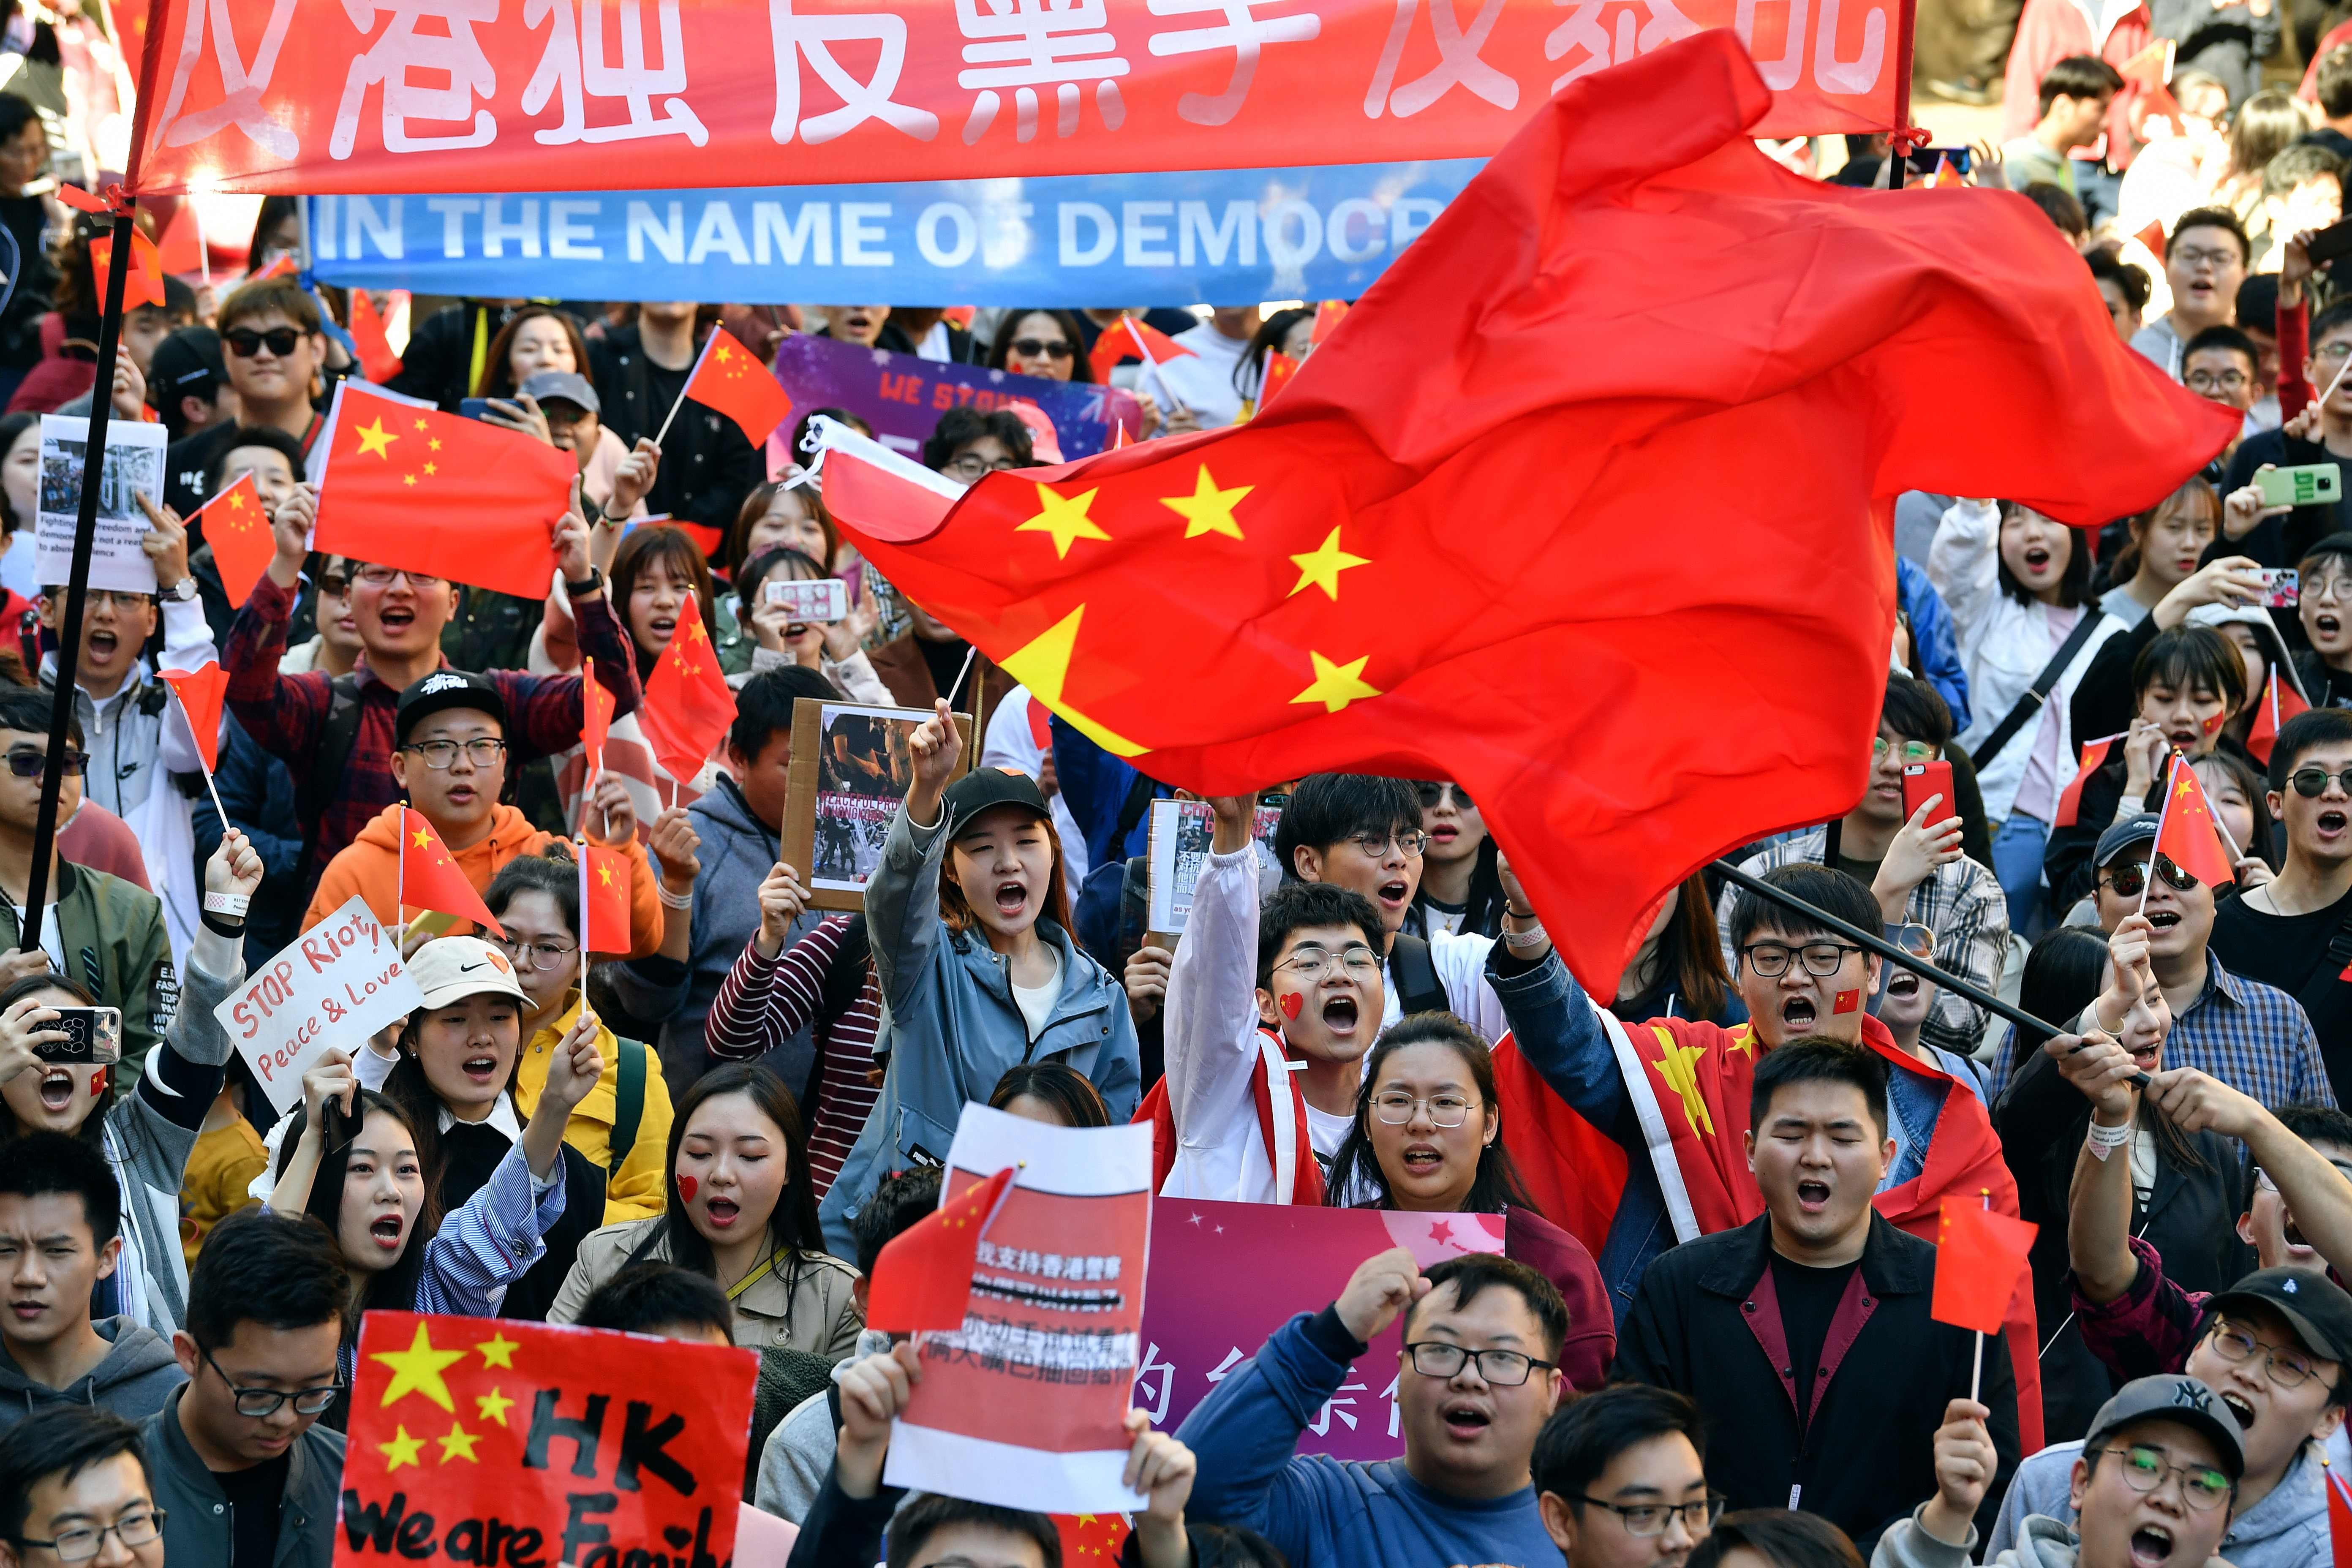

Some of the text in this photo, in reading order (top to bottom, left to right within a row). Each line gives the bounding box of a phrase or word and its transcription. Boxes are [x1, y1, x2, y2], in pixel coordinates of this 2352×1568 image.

[316, 195, 404, 260] IN
[427, 199, 604, 259] THE
[627, 199, 894, 267] NAME
[915, 201, 1034, 268] OF
[879, 372, 923, 406] WE
[39, 543, 47, 551] to
[820, 789, 875, 809] PEACEFUL
[232, 960, 294, 1039] STOP
[258, 962, 403, 1082] Peace & Love
[2172, 1380, 2213, 1411] NY
[522, 1388, 698, 1496] HK
[343, 1489, 438, 1560] We
[445, 1517, 546, 1568] are
